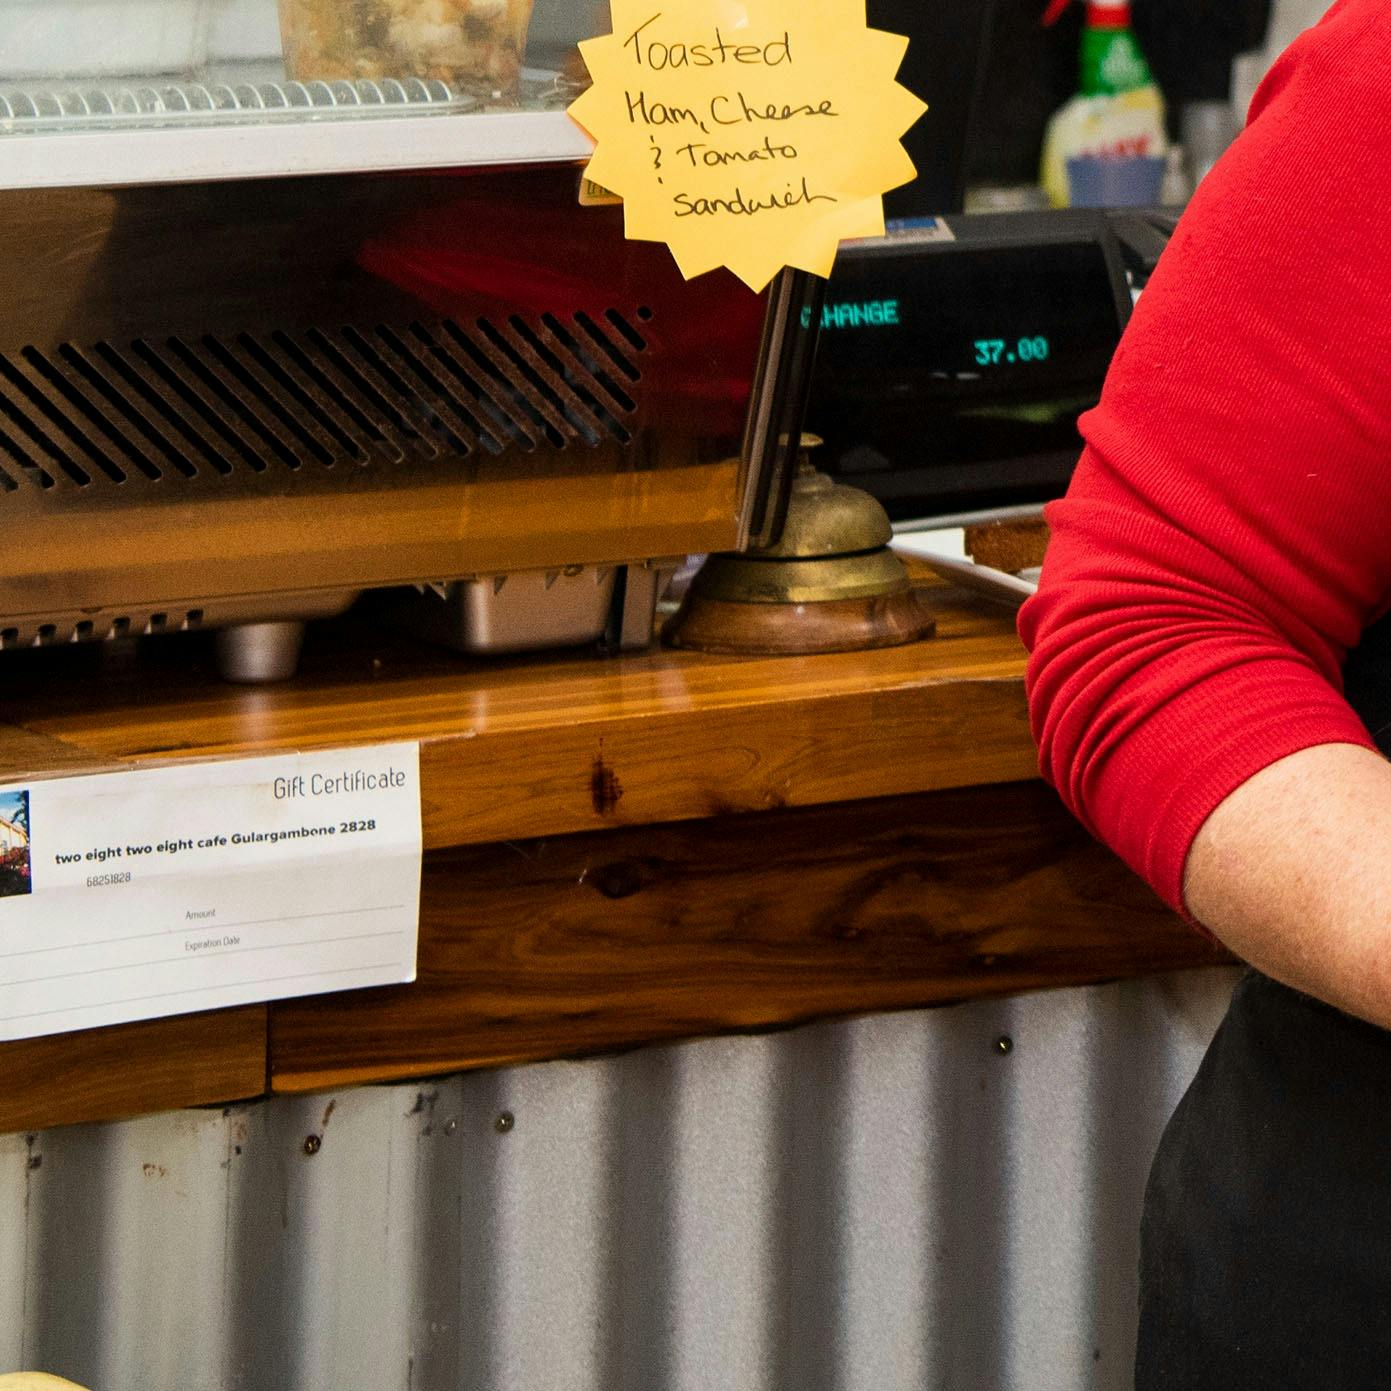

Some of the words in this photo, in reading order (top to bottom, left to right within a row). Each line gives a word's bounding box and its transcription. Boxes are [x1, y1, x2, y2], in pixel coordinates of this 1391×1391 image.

[624, 12, 793, 71] Toasted
[625, 90, 711, 134] Ham,
[710, 91, 840, 126] Cheese
[675, 135, 799, 168] Tomato
[800, 299, 900, 329] CHANGE
[973, 335, 1049, 366] 37.00
[273, 774, 306, 800] Gift
[311, 766, 407, 798] Certificate
[55, 850, 82, 865] two
[86, 844, 123, 862] eight
[126, 840, 153, 856] two
[156, 837, 194, 855] eight
[197, 833, 228, 849] cafe
[231, 822, 336, 846] Gulargambone
[340, 818, 377, 834] 2828
[185, 907, 216, 921] Amount
[185, 939, 222, 952] Expiration
[223, 936, 241, 948] Date
